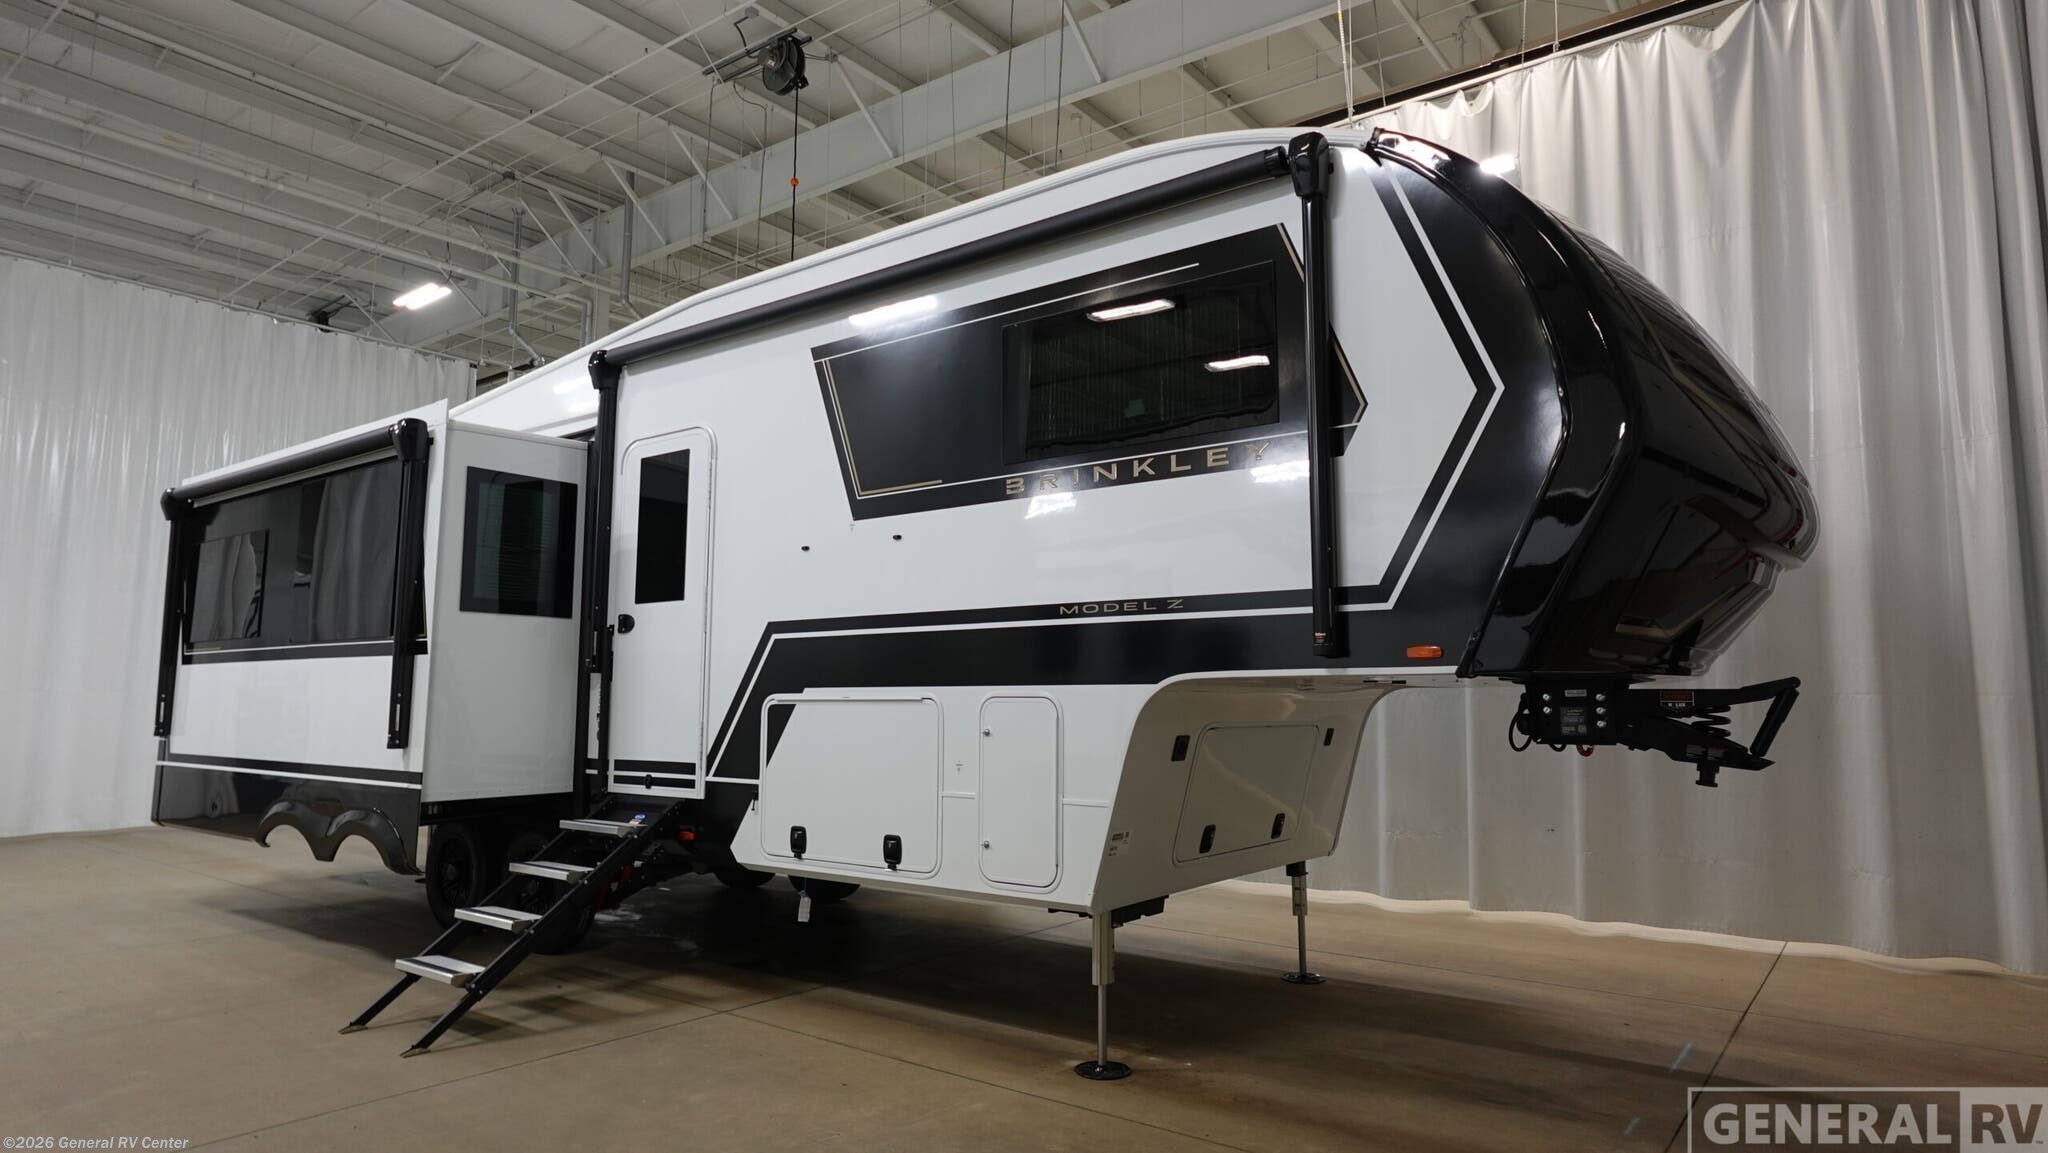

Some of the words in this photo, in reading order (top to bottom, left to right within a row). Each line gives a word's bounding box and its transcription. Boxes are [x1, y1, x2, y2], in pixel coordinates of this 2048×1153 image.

[1005, 441, 1272, 496] BRINKLEY
[1059, 601, 1157, 616] MODEL
[1166, 598, 1184, 609] Z
